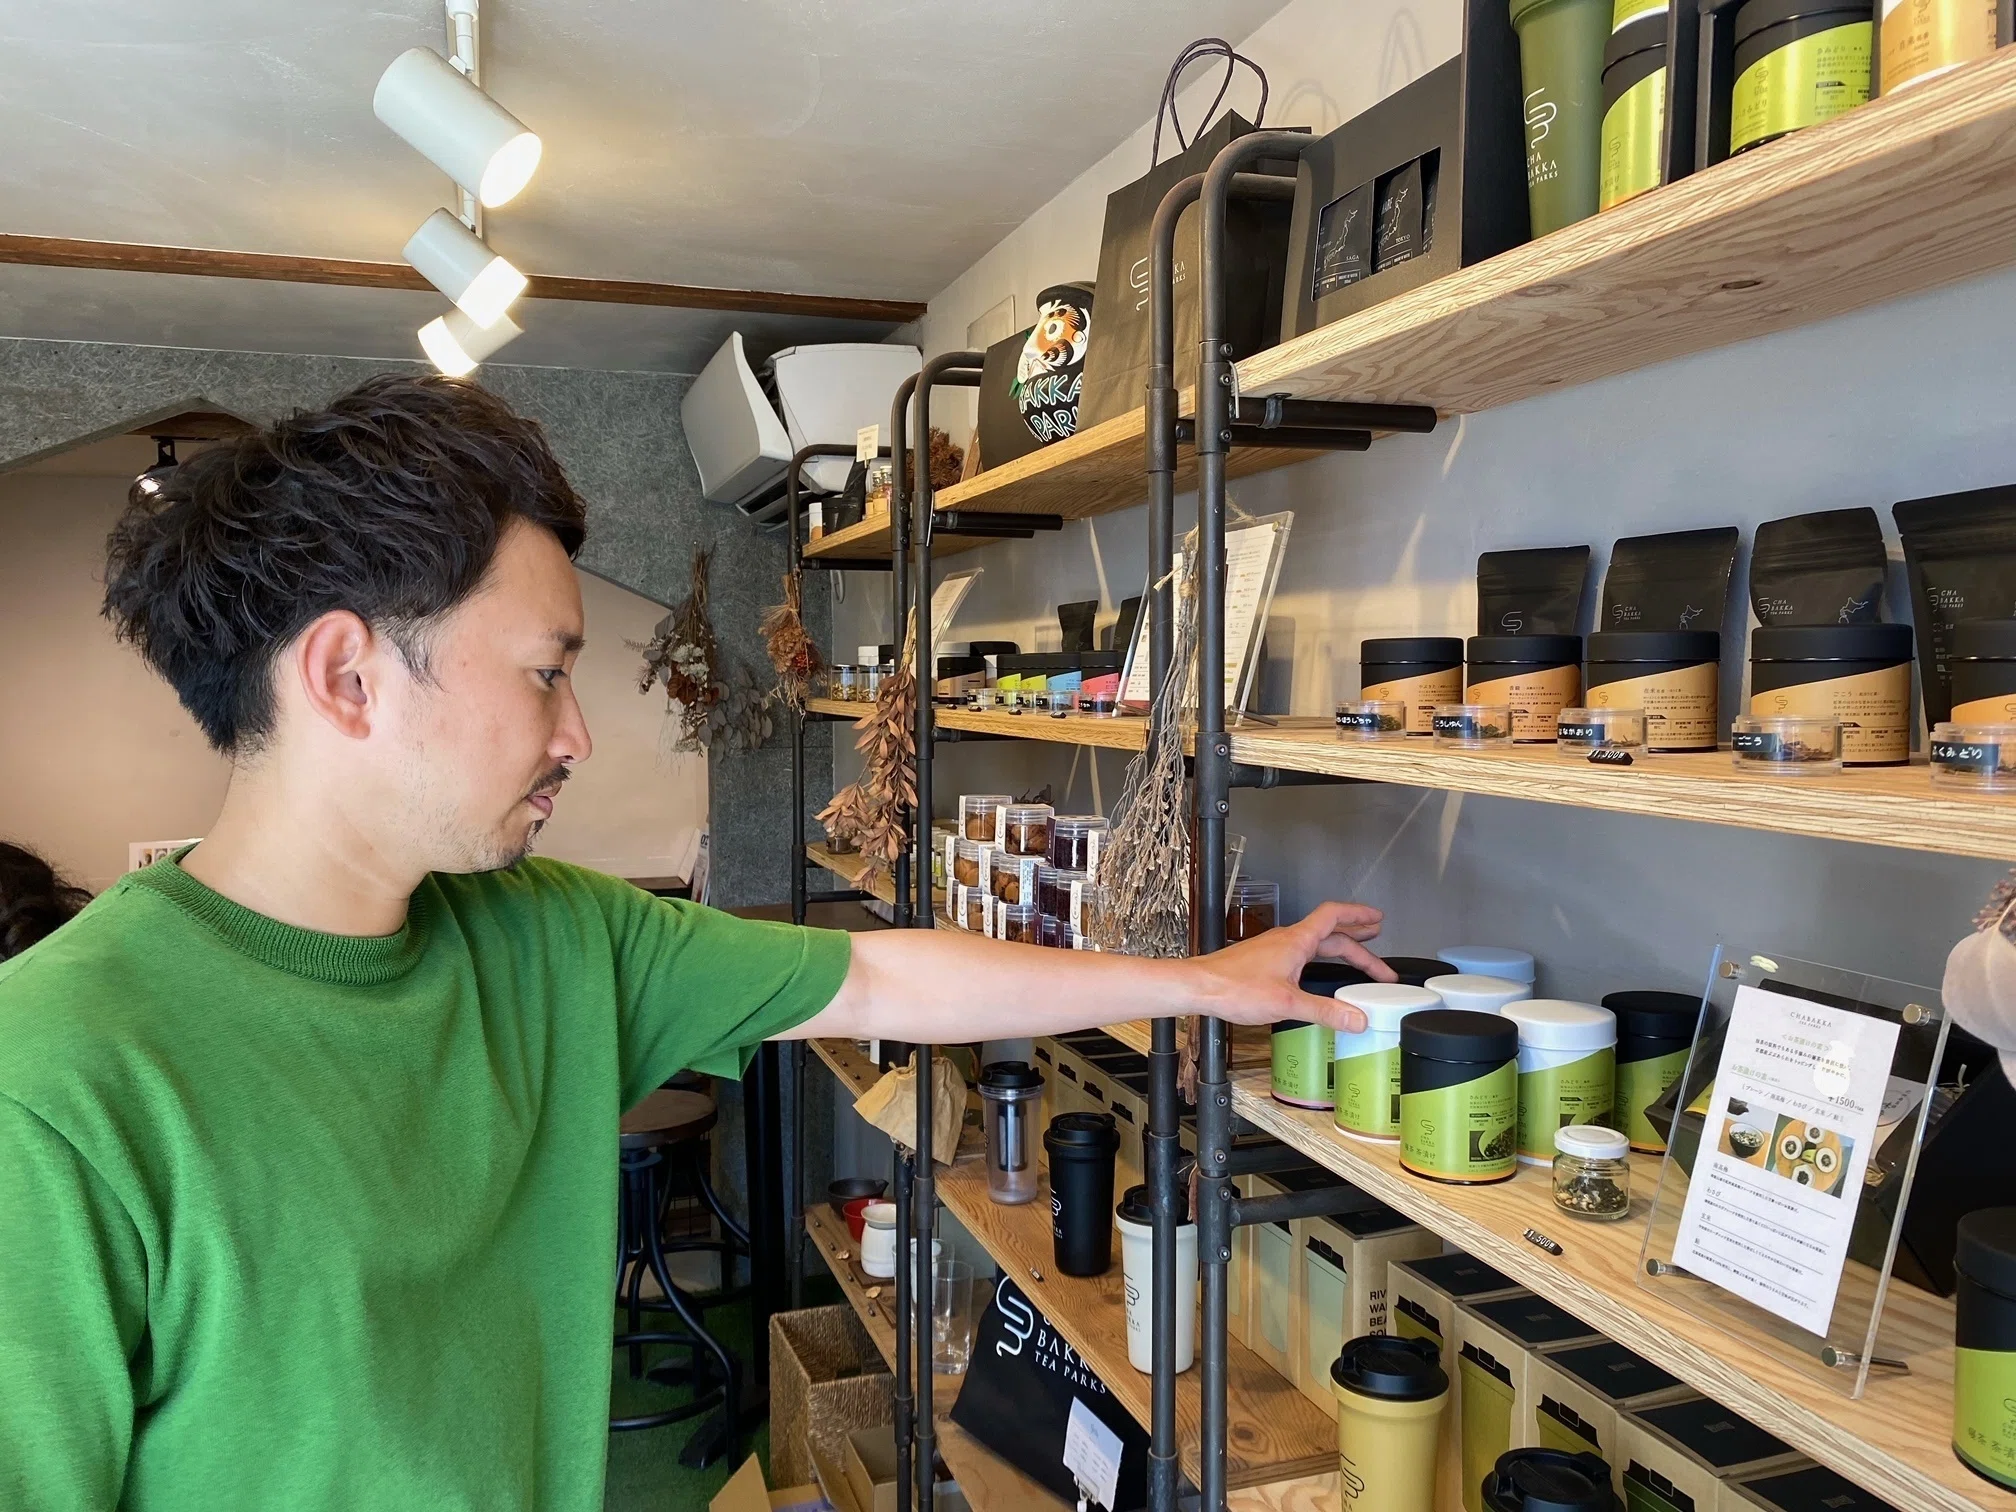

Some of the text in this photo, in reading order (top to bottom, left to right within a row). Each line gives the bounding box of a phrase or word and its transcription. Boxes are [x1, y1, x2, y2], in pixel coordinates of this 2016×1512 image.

[1536, 170, 1558, 184] PARKS
[1019, 372, 1083, 414] AKKA
[1030, 406, 1078, 441] PAR
[1738, 735, 1763, 746] ごこう
[1790, 1012, 1832, 1028] CHABAKKA
[1034, 1350, 1106, 1394] TEA PARKS
